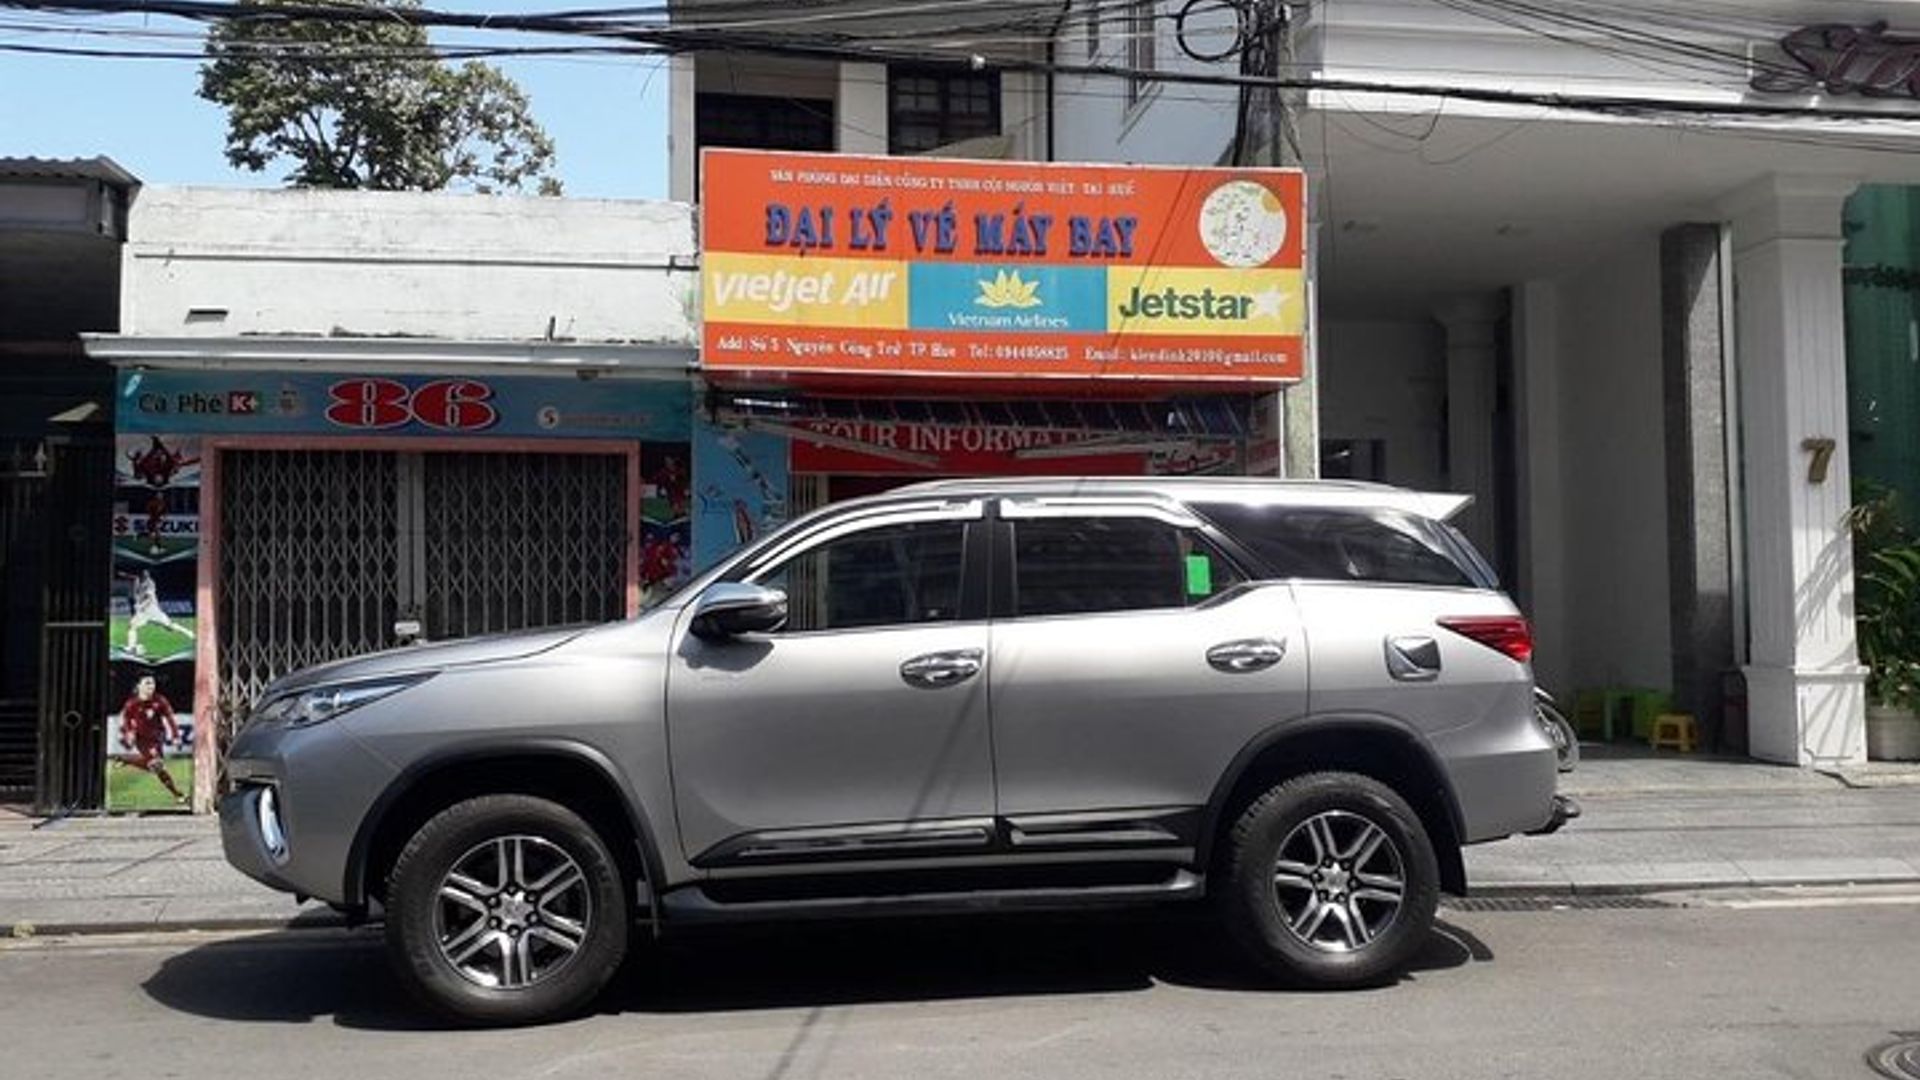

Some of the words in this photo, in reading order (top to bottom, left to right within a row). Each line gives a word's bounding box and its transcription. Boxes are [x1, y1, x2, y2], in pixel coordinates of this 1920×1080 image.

[765, 203, 835, 257] ĐẠI
[849, 198, 893, 250] LÝ
[974, 201, 1053, 256] MÁY
[1068, 213, 1138, 258] BAY
[842, 271, 897, 307] Air
[1118, 286, 1254, 320] Jetstar
[325, 377, 496, 430] 86
[1801, 438, 1836, 484] 7
[132, 517, 199, 533] SZUKI
